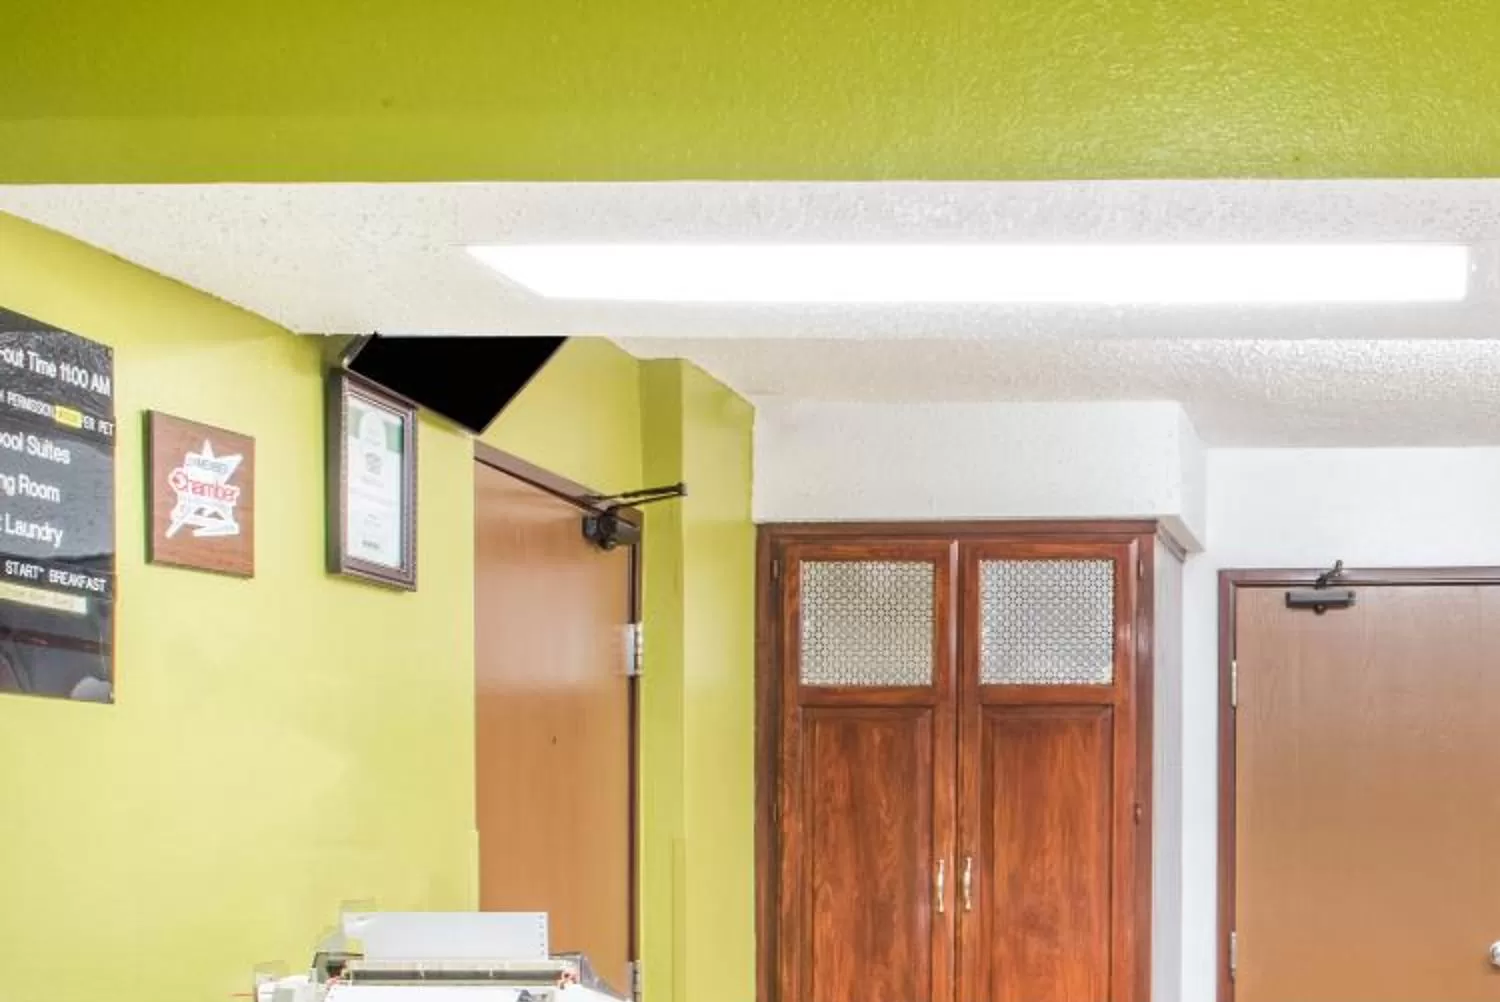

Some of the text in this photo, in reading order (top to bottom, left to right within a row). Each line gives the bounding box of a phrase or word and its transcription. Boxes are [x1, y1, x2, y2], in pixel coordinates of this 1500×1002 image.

[27, 350, 57, 378] Time
[90, 373, 111, 397] AM
[27, 435, 71, 465] Suites
[18, 473, 61, 504] Room
[5, 512, 64, 548] Laundry
[48, 568, 107, 592] BREAKFAST
